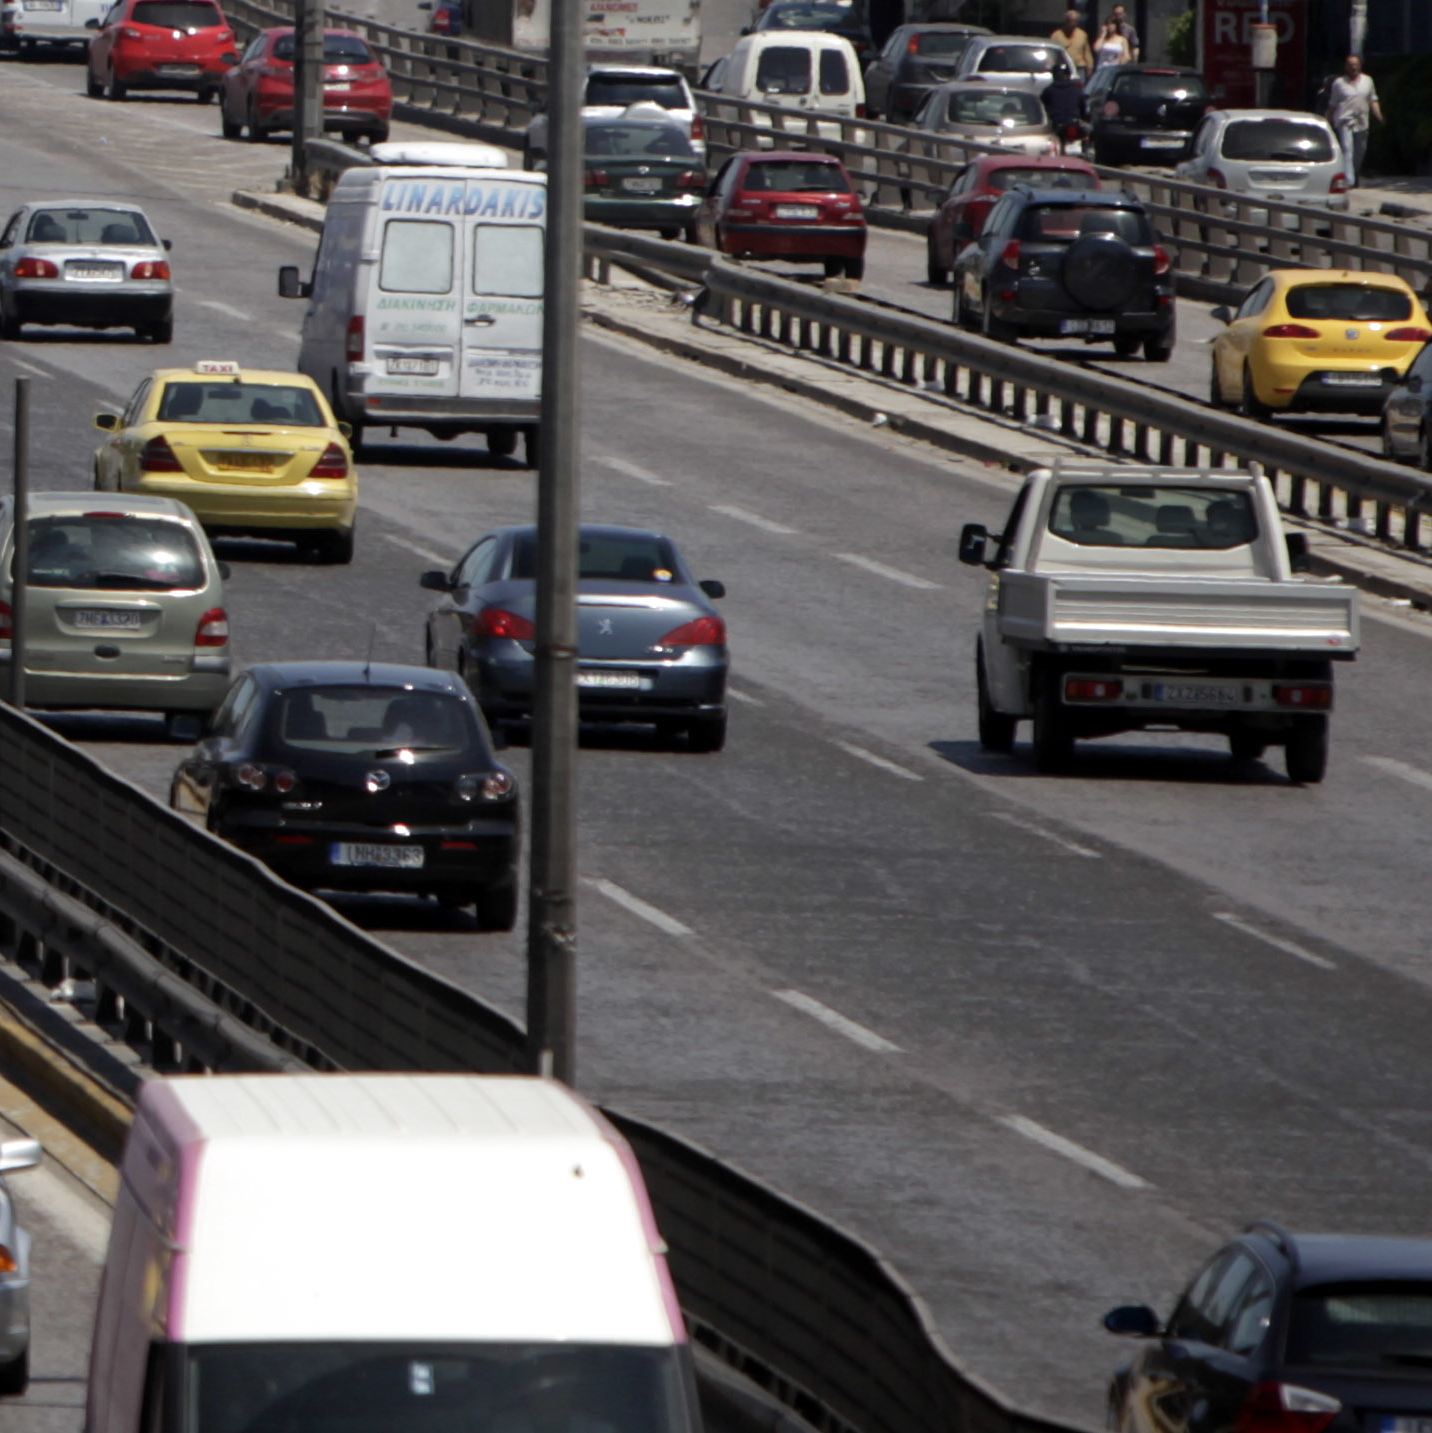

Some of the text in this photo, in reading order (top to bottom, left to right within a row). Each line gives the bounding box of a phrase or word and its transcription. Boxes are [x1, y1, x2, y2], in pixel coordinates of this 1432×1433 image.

[382, 181, 546, 218] LINARDAKIS
[376, 297, 456, 312] ΔΙΑΚΙΝΗΣΗ
[202, 364, 234, 373] TAXI
